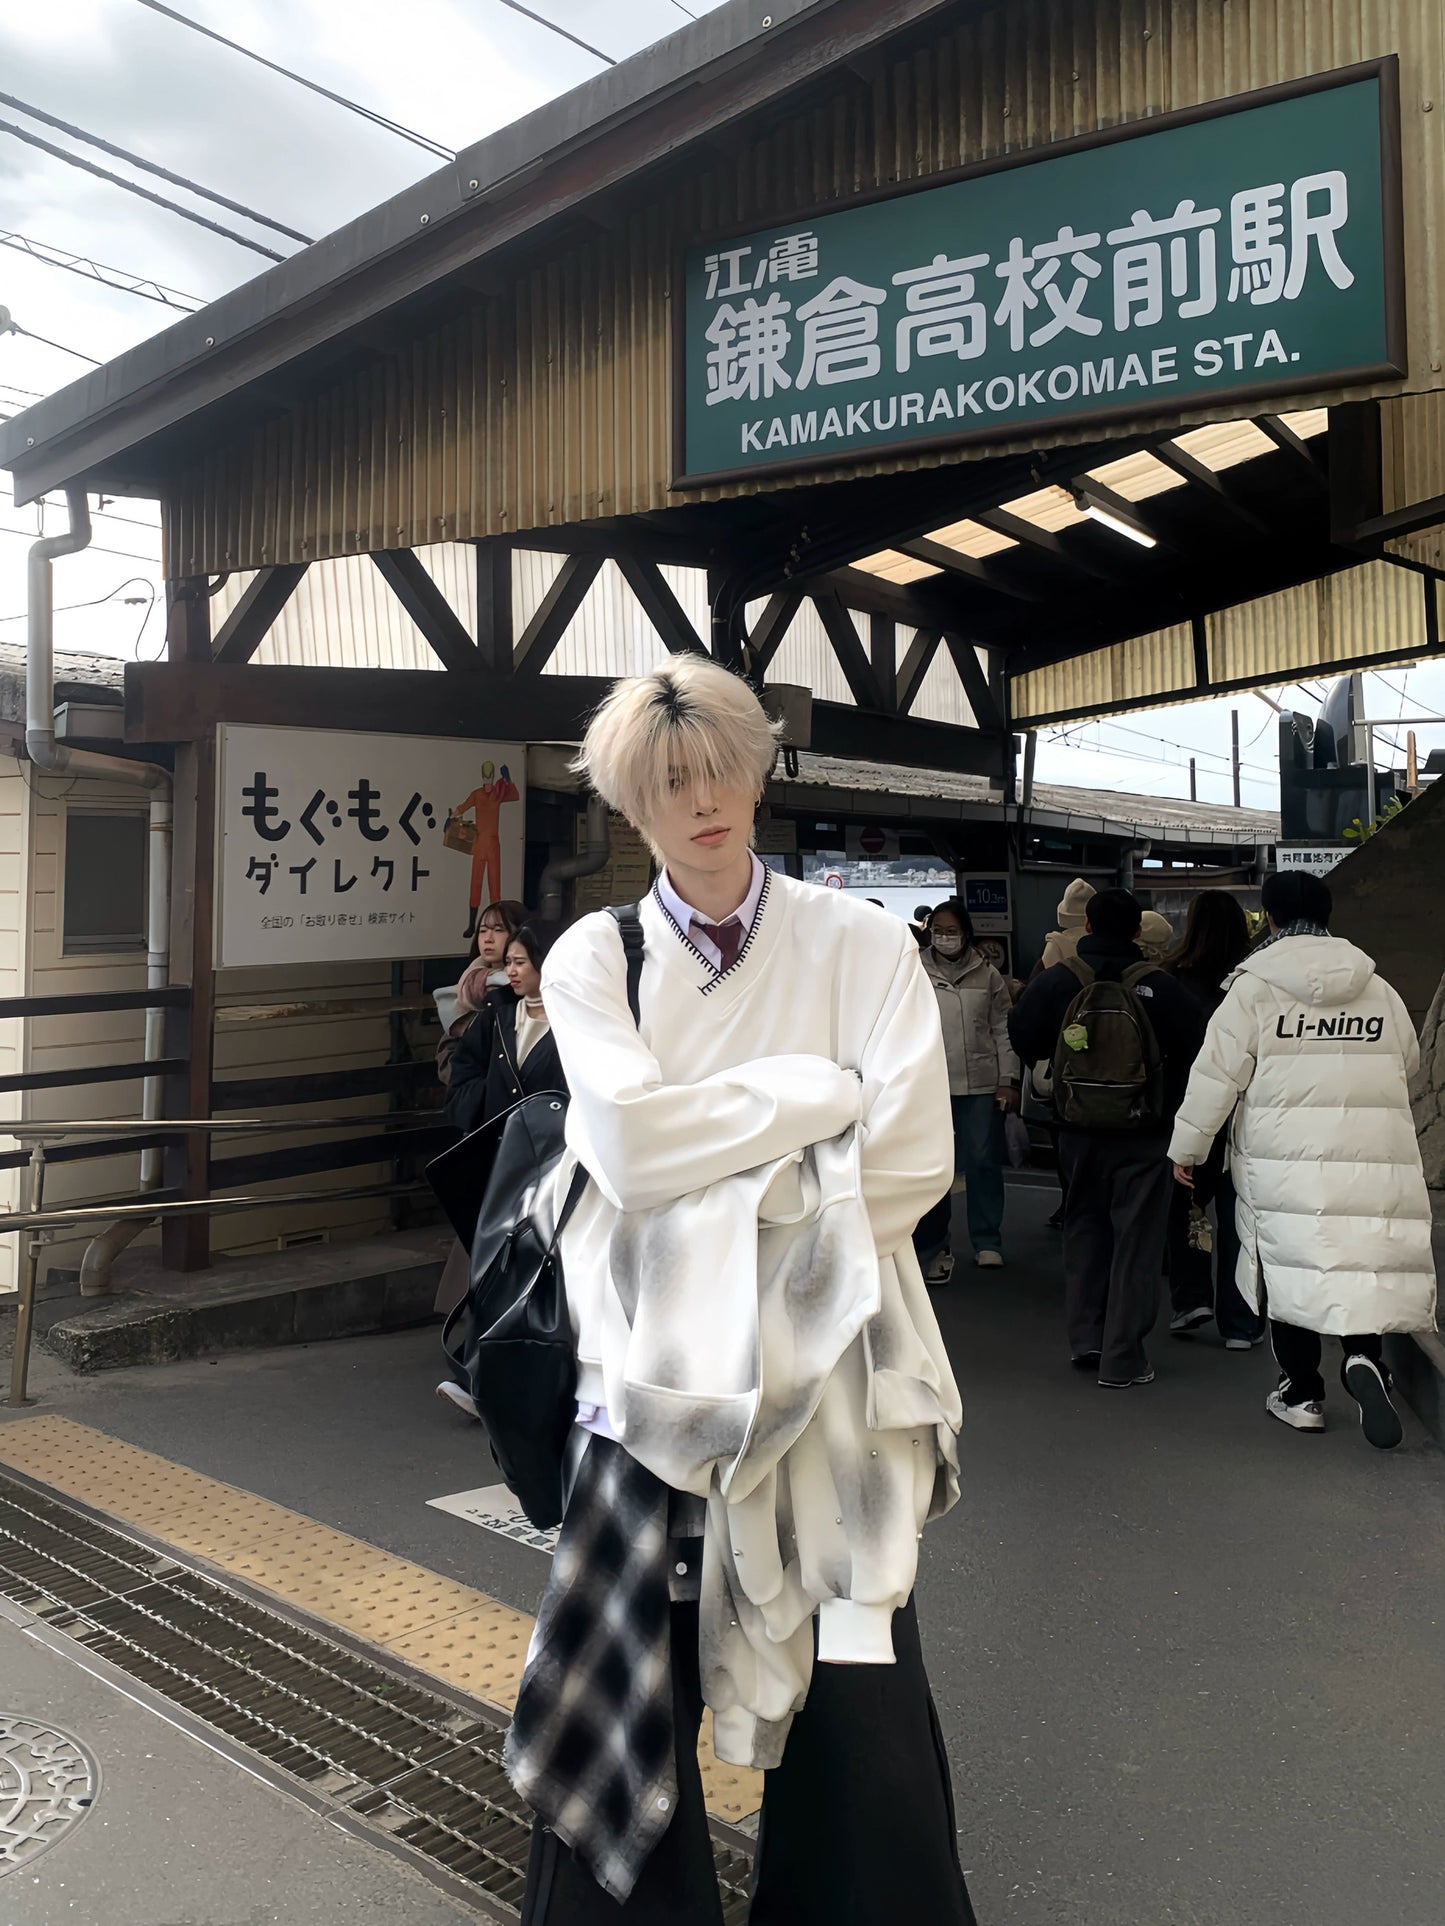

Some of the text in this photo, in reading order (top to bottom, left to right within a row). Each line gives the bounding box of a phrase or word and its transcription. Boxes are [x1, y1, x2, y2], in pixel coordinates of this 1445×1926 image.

[706, 169, 1355, 407] 鎌倉高校前駅
[741, 329, 1301, 454] KAMAKURAKOKOMAE STA.
[242, 772, 437, 846] もぐもぐ
[245, 852, 430, 895] ダイレクト
[1275, 1011, 1385, 1042] Li-Ning
